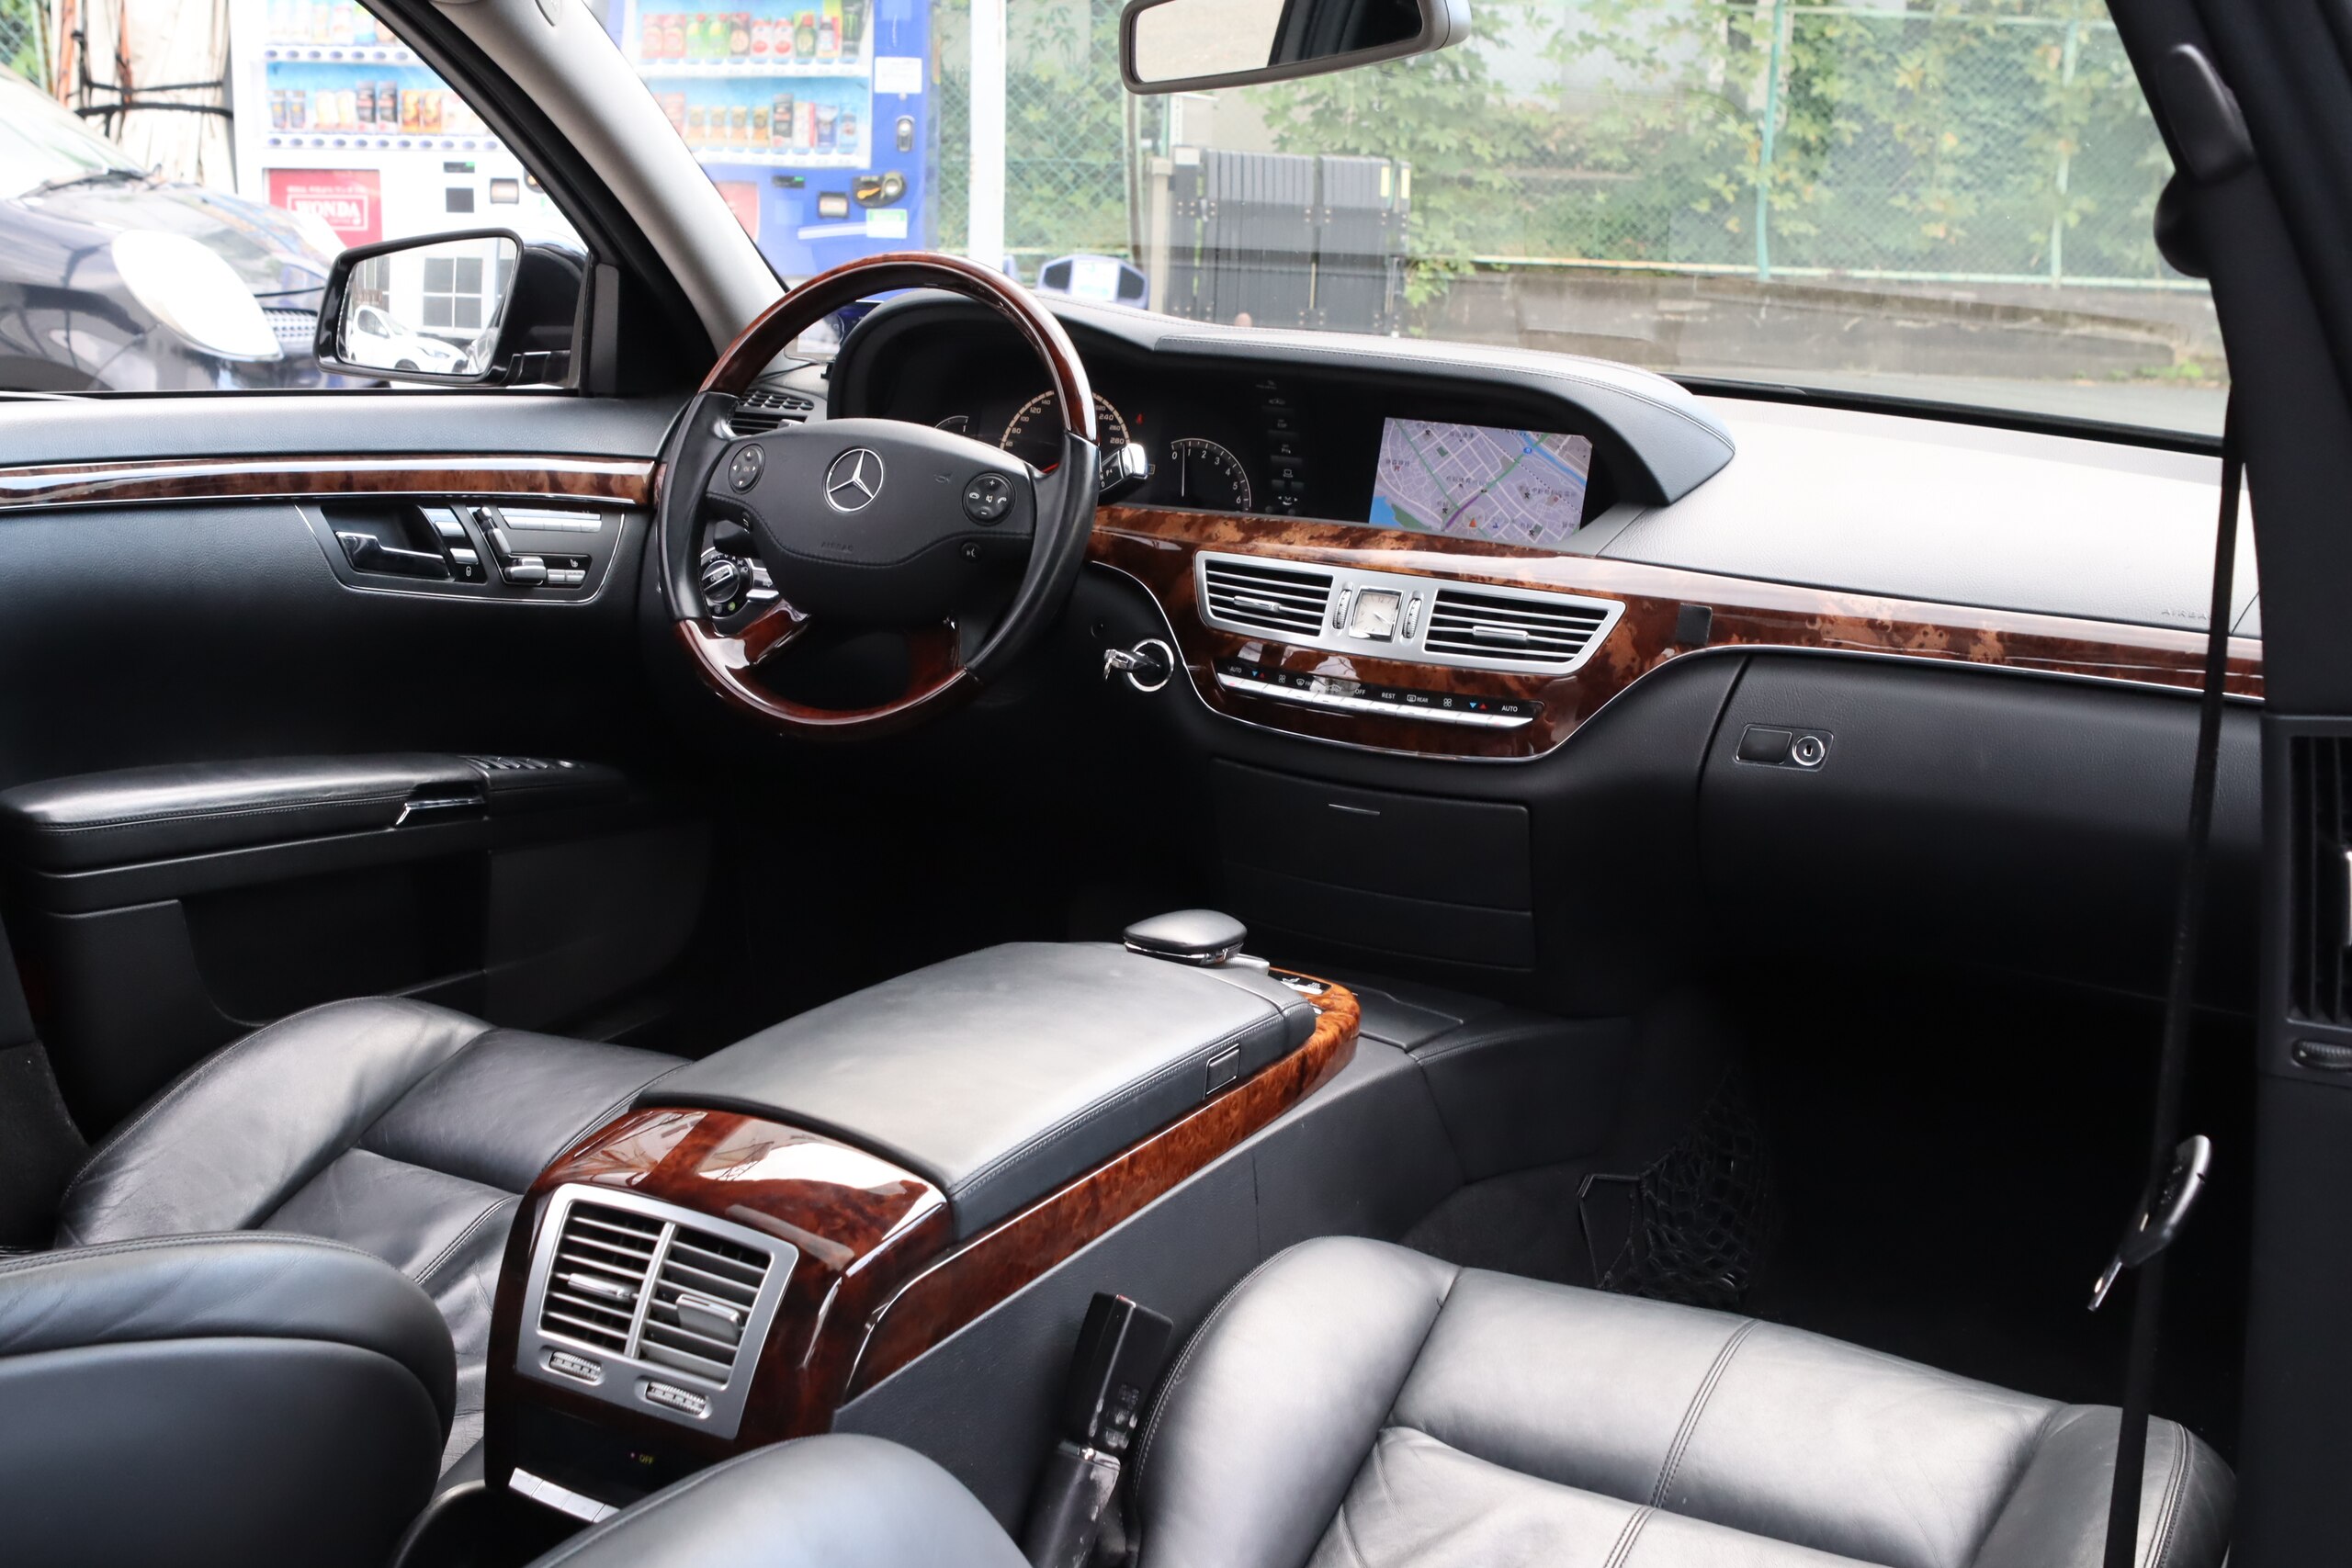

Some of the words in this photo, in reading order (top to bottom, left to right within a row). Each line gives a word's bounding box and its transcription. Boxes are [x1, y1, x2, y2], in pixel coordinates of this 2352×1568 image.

[1171, 451, 1178, 459] 0
[1187, 448, 1192, 457] 1
[1201, 450, 1207, 459] 2
[1215, 457, 1220, 466] 3
[1225, 468, 1231, 476] 4
[1232, 481, 1238, 490] 5
[1236, 495, 1241, 504] 6
[2161, 608, 2210, 621] AIRBA
[1354, 688, 1366, 696] OFF
[1381, 692, 1396, 700] REST
[1501, 705, 1518, 713] AUTO
